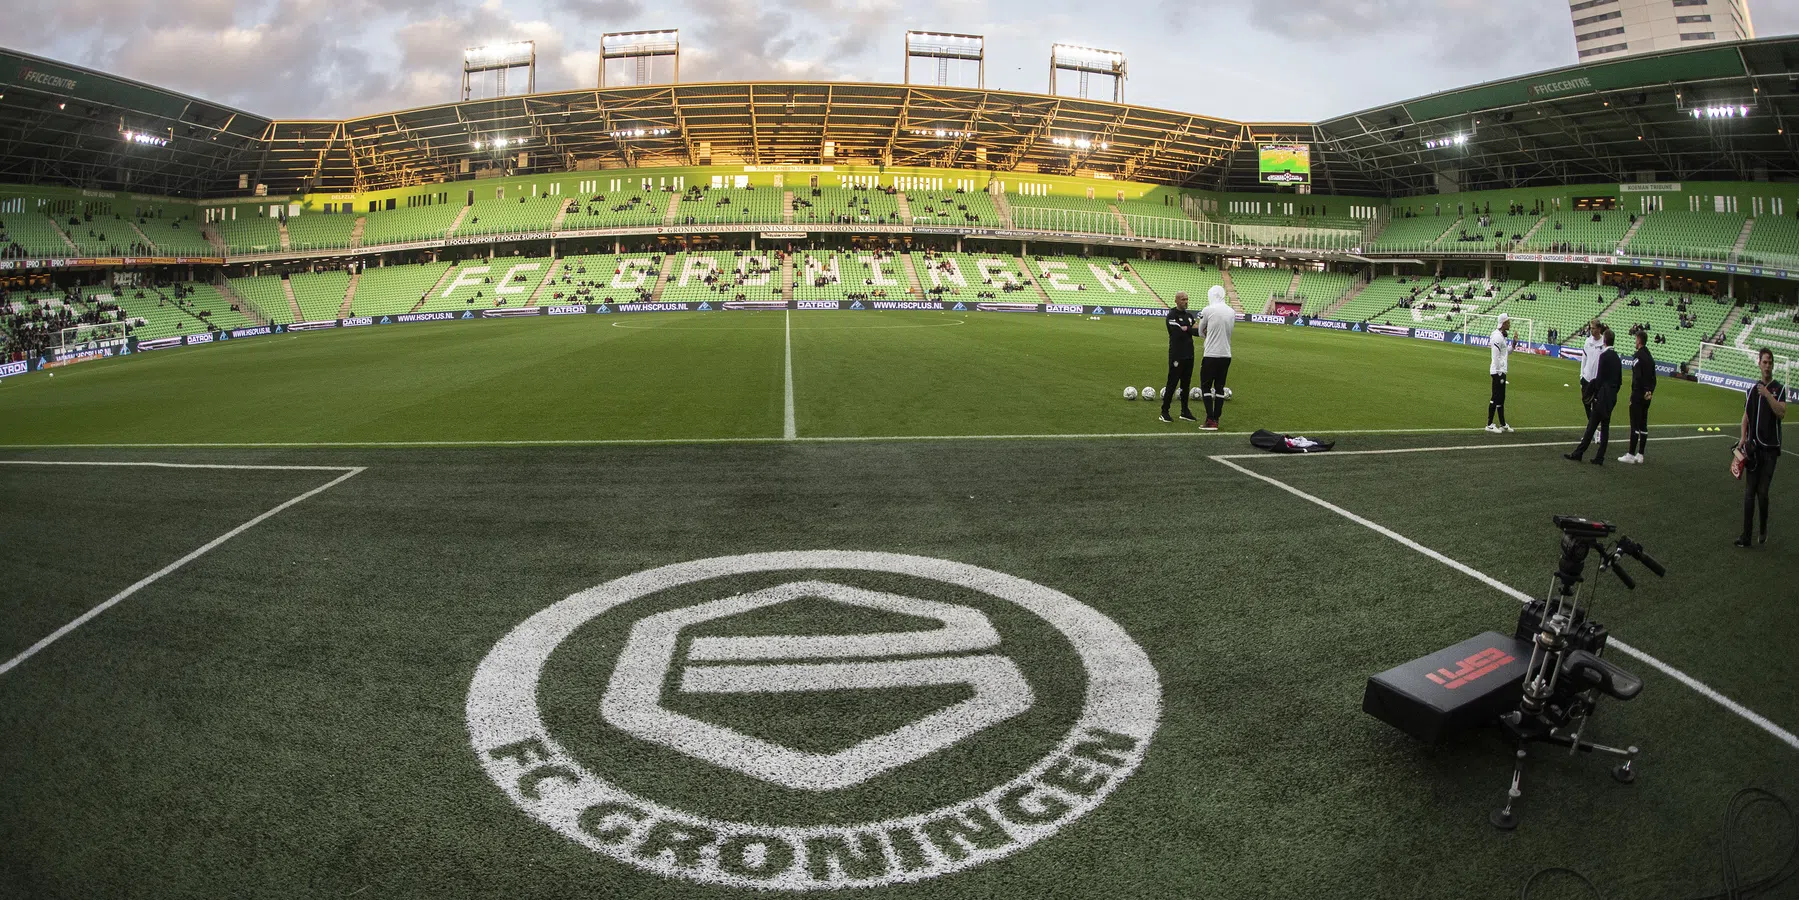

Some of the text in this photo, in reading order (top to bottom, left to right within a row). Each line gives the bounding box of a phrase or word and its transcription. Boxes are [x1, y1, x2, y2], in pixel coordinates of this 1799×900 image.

[521, 233, 551, 241] SUPPORT
[440, 263, 541, 298] FC
[548, 305, 586, 314] DATRON
[619, 303, 688, 312] WWW.HSCPLUS.NL
[798, 301, 839, 309] DATRON
[874, 301, 944, 310] WWW.HSCPLUS.NL
[1046, 304, 1083, 313] DATRON
[1113, 307, 1169, 317] WWW.HSCPLUS.N
[398, 312, 455, 322] WWW.HSCPLUS.NL
[1252, 315, 1285, 324] DATRON
[343, 318, 372, 326] DATRON
[1309, 319, 1348, 329] WWW.HSCPLUS.NL
[232, 327, 271, 338] WWW.HSCPLUS.NL
[1415, 329, 1445, 341] DATRON
[187, 333, 213, 345] DATRON
[488, 727, 1138, 881] FC GRONINGEN
